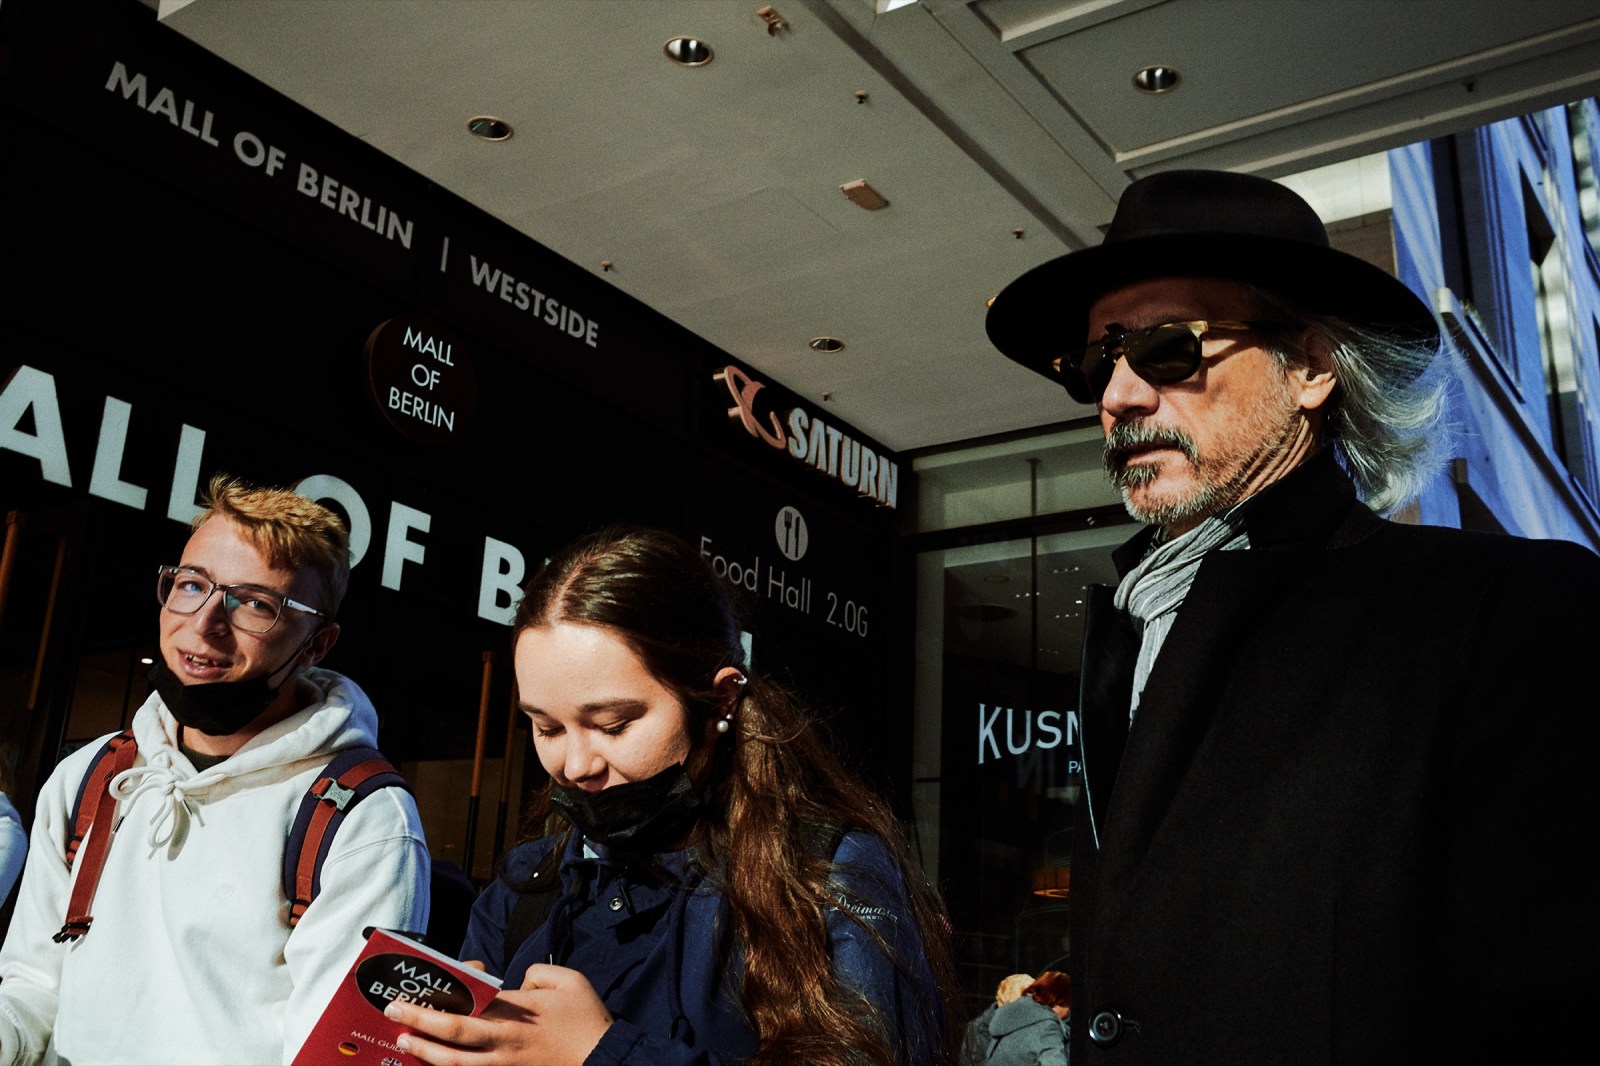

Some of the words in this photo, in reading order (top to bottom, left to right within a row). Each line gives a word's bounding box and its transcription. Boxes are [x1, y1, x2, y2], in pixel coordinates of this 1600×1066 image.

[105, 61, 219, 147] MALL
[233, 131, 286, 177] OF
[296, 162, 414, 249] BERLIN
[470, 255, 599, 348] WESTSIDE
[402, 326, 455, 367] MALL
[411, 363, 441, 391] OF
[388, 386, 455, 432] BERLIN
[788, 406, 898, 509] SATURN
[700, 535, 759, 593] Food
[768, 565, 811, 614] Hall
[393, 960, 452, 995] MALL
[399, 979, 434, 998] OF
[350, 1030, 375, 1044] MALL
